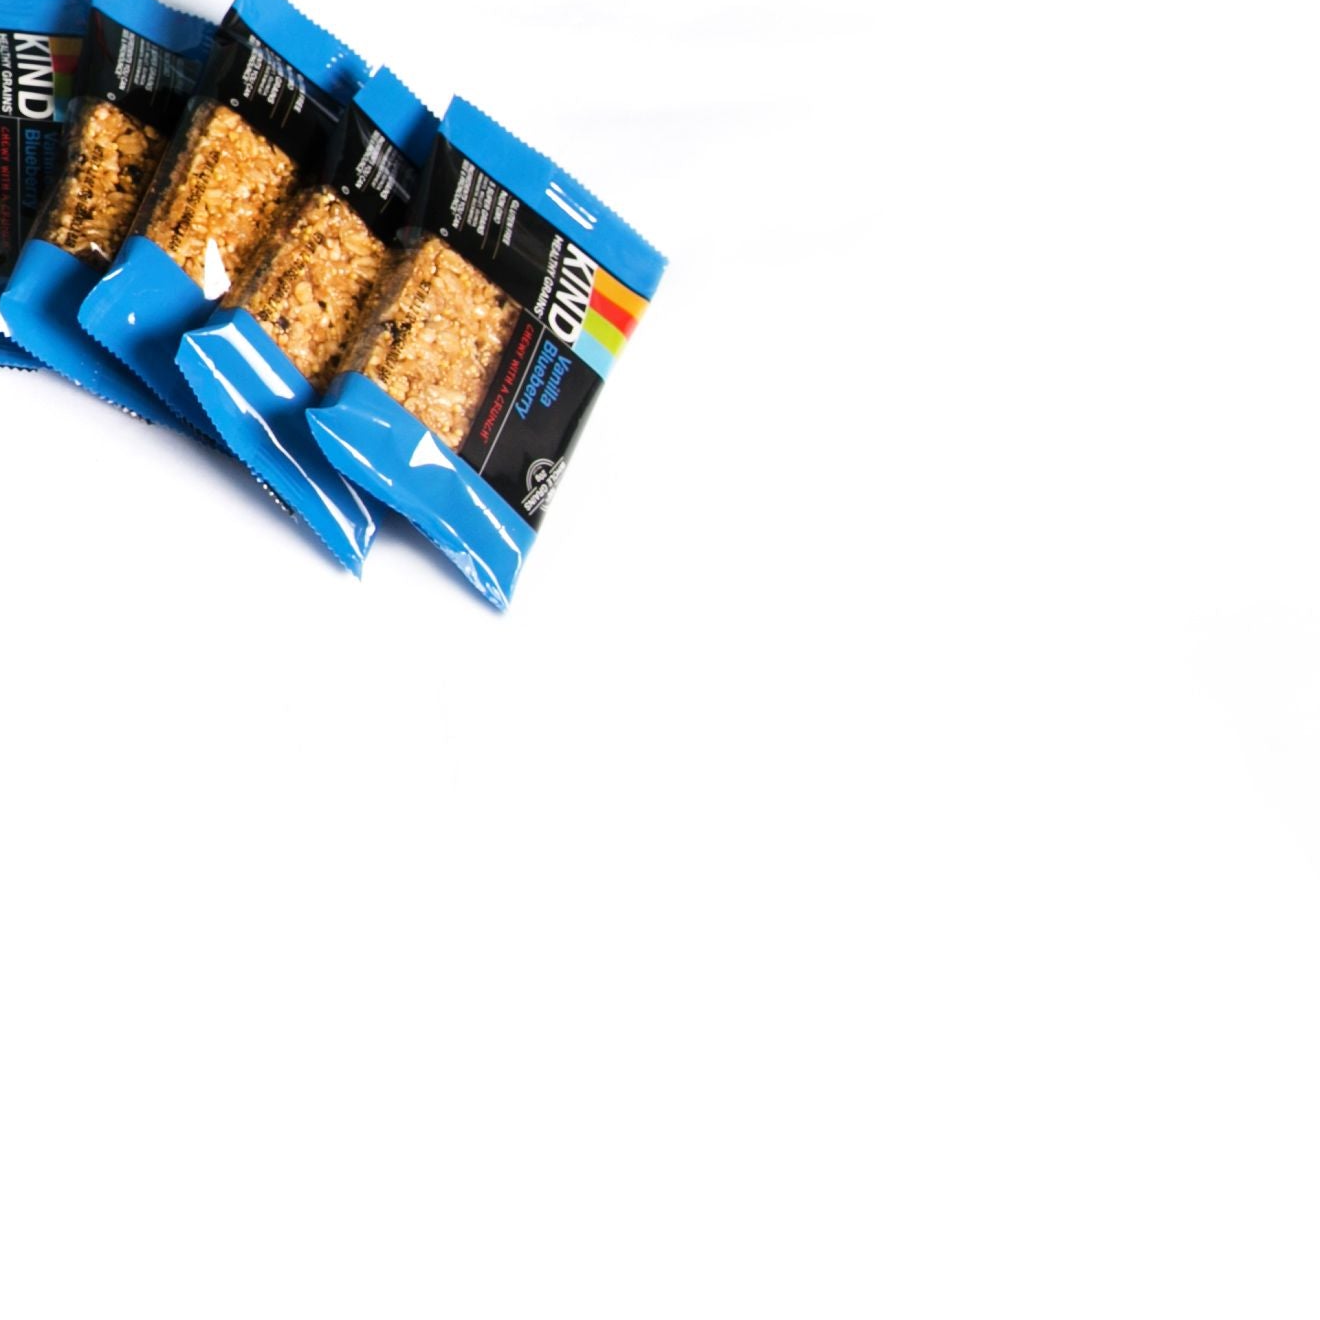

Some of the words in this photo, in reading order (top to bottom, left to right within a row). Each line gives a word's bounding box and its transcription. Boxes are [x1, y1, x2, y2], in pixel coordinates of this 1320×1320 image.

[1, 70, 12, 114] GRAINS
[14, 33, 54, 119] KIND
[22, 129, 41, 208] Blueberry
[547, 234, 564, 278] HEALTHY
[533, 277, 554, 317] GRAINS
[548, 243, 598, 343] KIND
[516, 323, 534, 360] CHEWY
[500, 386, 510, 394] A
[507, 359, 520, 385] WITH
[515, 340, 558, 420] Blueberry
[540, 355, 572, 408] Vanilla
[480, 398, 505, 442] CRUNCH
